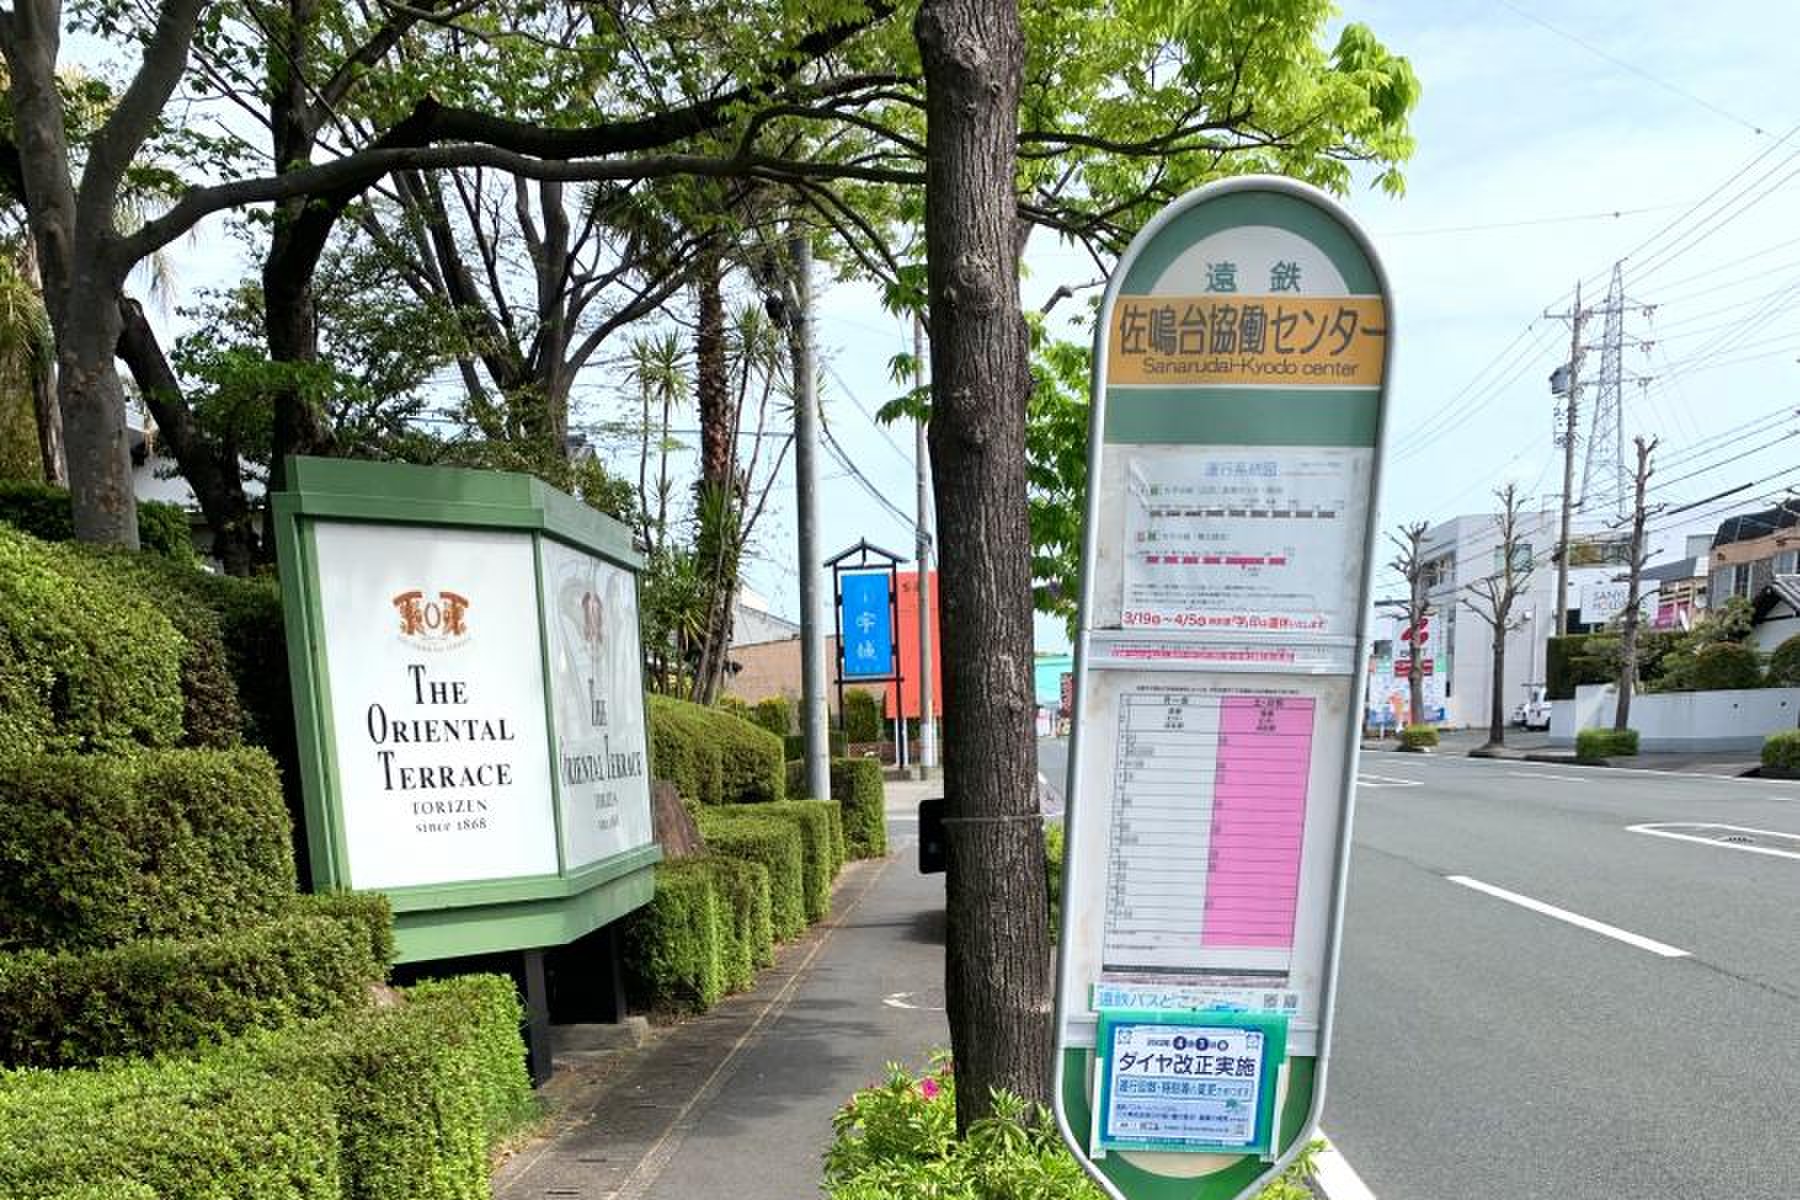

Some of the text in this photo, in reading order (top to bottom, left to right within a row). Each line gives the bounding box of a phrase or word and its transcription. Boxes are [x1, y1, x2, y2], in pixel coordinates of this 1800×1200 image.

[1205, 261, 1301, 293] 遠鉄
[1120, 303, 1387, 356] 佐鳴台協働センター
[1302, 361, 1360, 376] center
[407, 664, 468, 704] THE
[367, 703, 514, 744] ORIENTAL
[377, 749, 513, 791] TERRACE
[457, 817, 488, 831] 1868
[1118, 1051, 1257, 1077] ダイヤ改正実施
